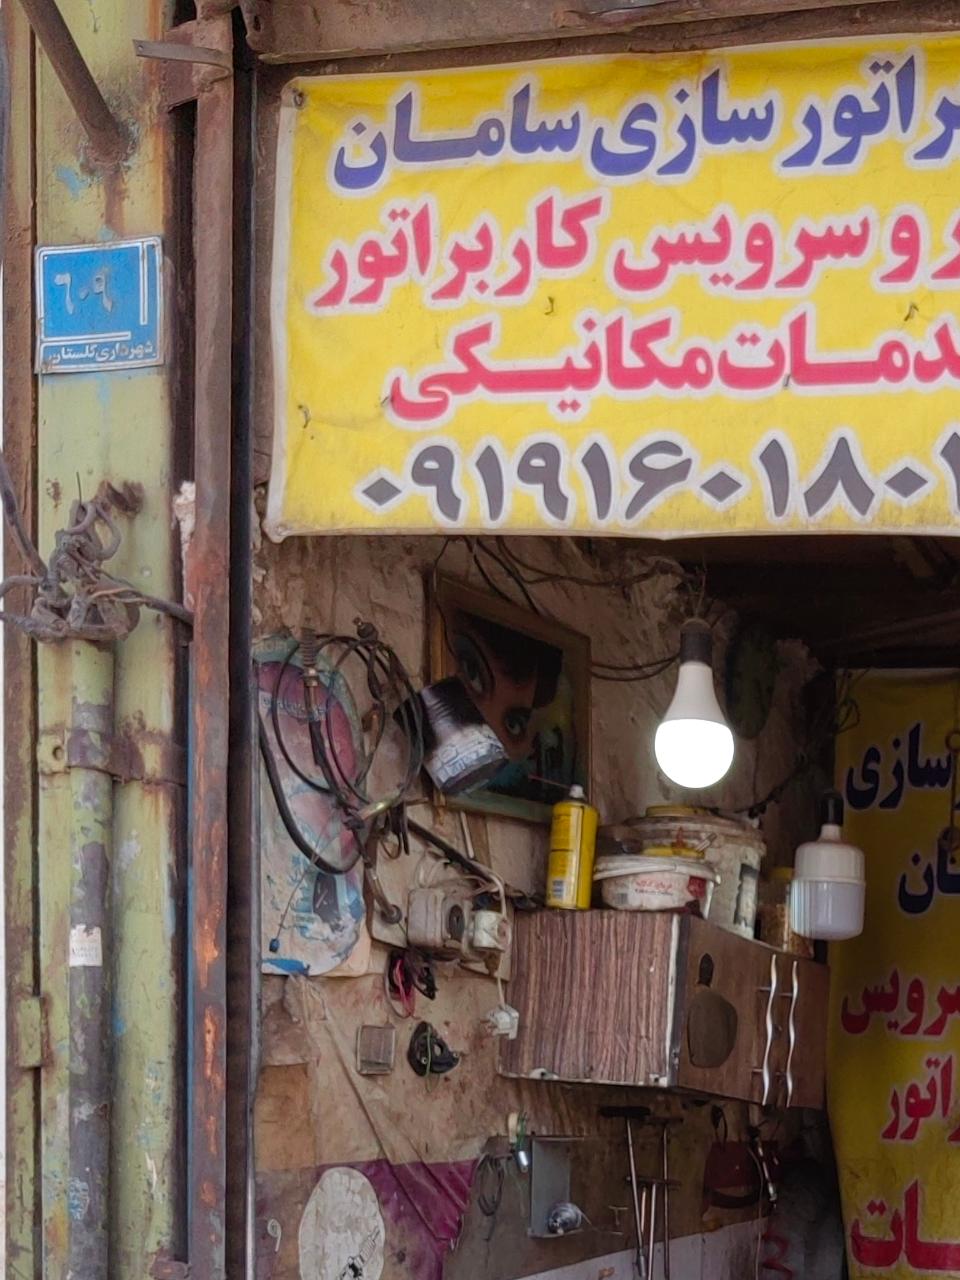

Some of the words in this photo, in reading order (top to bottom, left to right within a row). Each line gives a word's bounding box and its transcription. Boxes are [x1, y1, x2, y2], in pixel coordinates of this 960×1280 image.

[332, 84, 581, 189] سامان
[590, 70, 776, 177] سازی
[314, 196, 602, 307] کاربراتور
[613, 213, 870, 291] سرویس
[881, 213, 921, 283] و
[96, 340, 154, 361] شهرداری
[389, 316, 715, 421] مکانیکی
[845, 723, 952, 811] سازی
